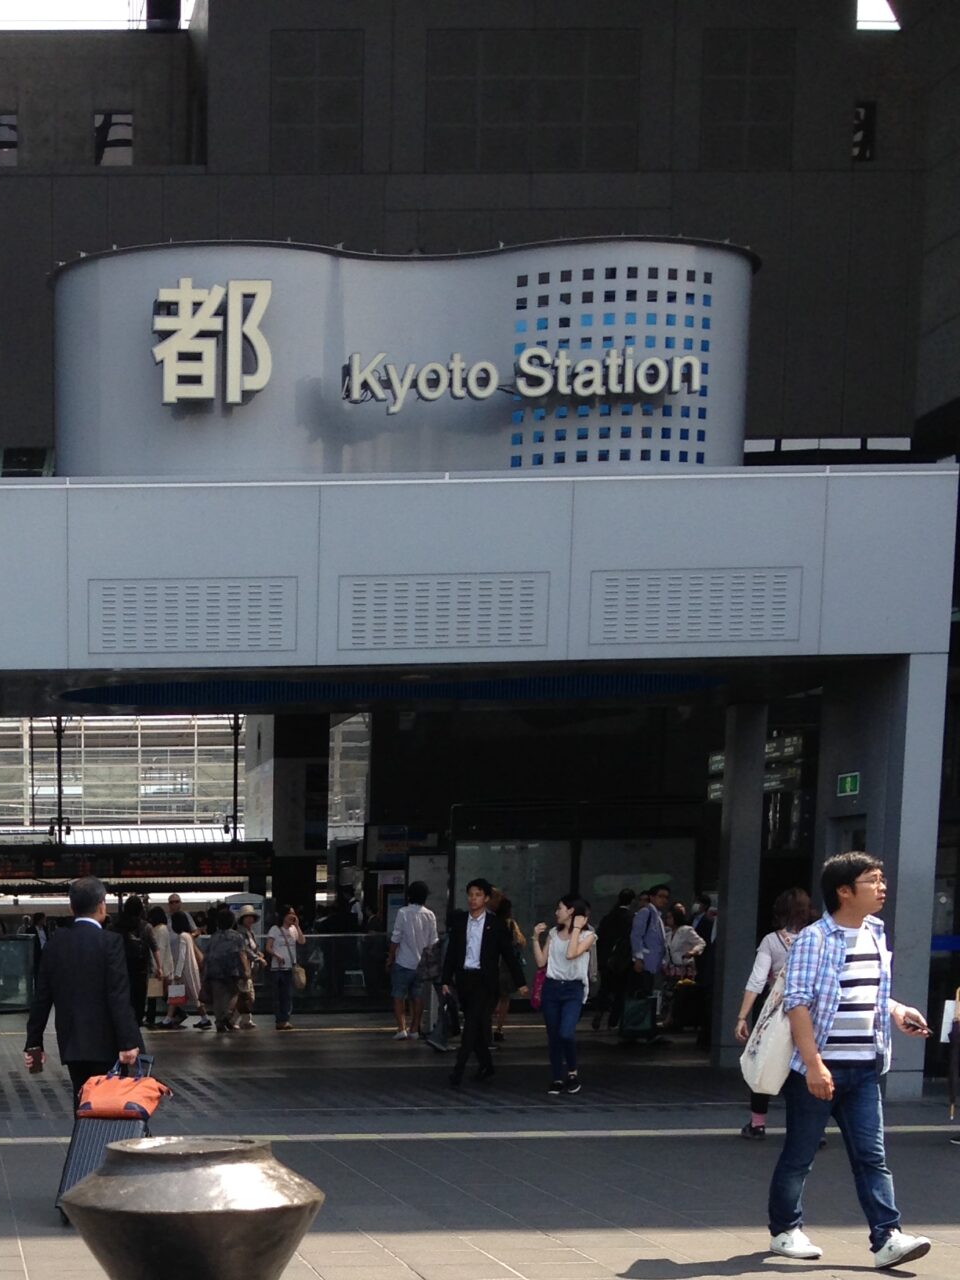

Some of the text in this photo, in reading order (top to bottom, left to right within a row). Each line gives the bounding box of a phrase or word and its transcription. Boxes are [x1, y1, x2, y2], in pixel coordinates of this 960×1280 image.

[152, 277, 272, 405] 都
[348, 347, 702, 415] Kyoto Station
